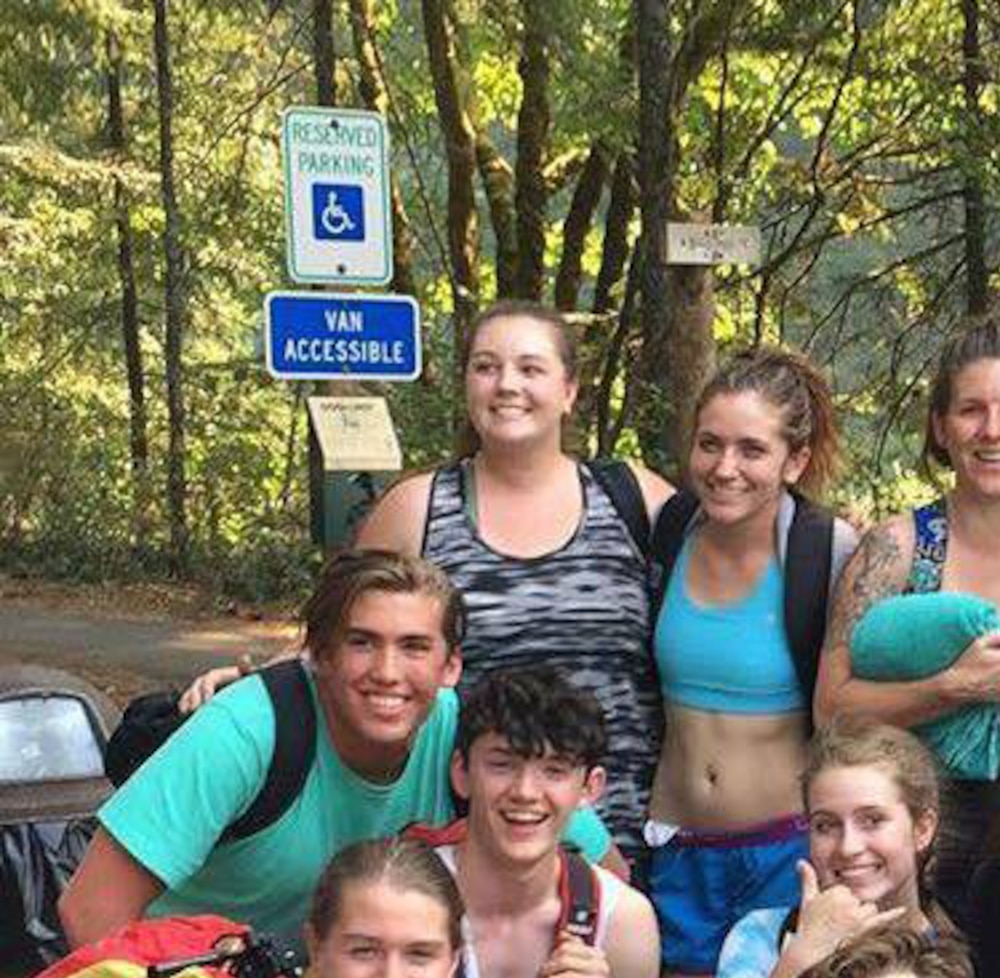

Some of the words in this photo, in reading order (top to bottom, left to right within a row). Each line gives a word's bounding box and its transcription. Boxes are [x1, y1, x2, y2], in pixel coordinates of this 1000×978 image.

[293, 122, 376, 147] RESERVED
[299, 152, 374, 177] PARKING
[323, 309, 364, 332] VAN
[284, 337, 405, 364] ACCESSIBLE
